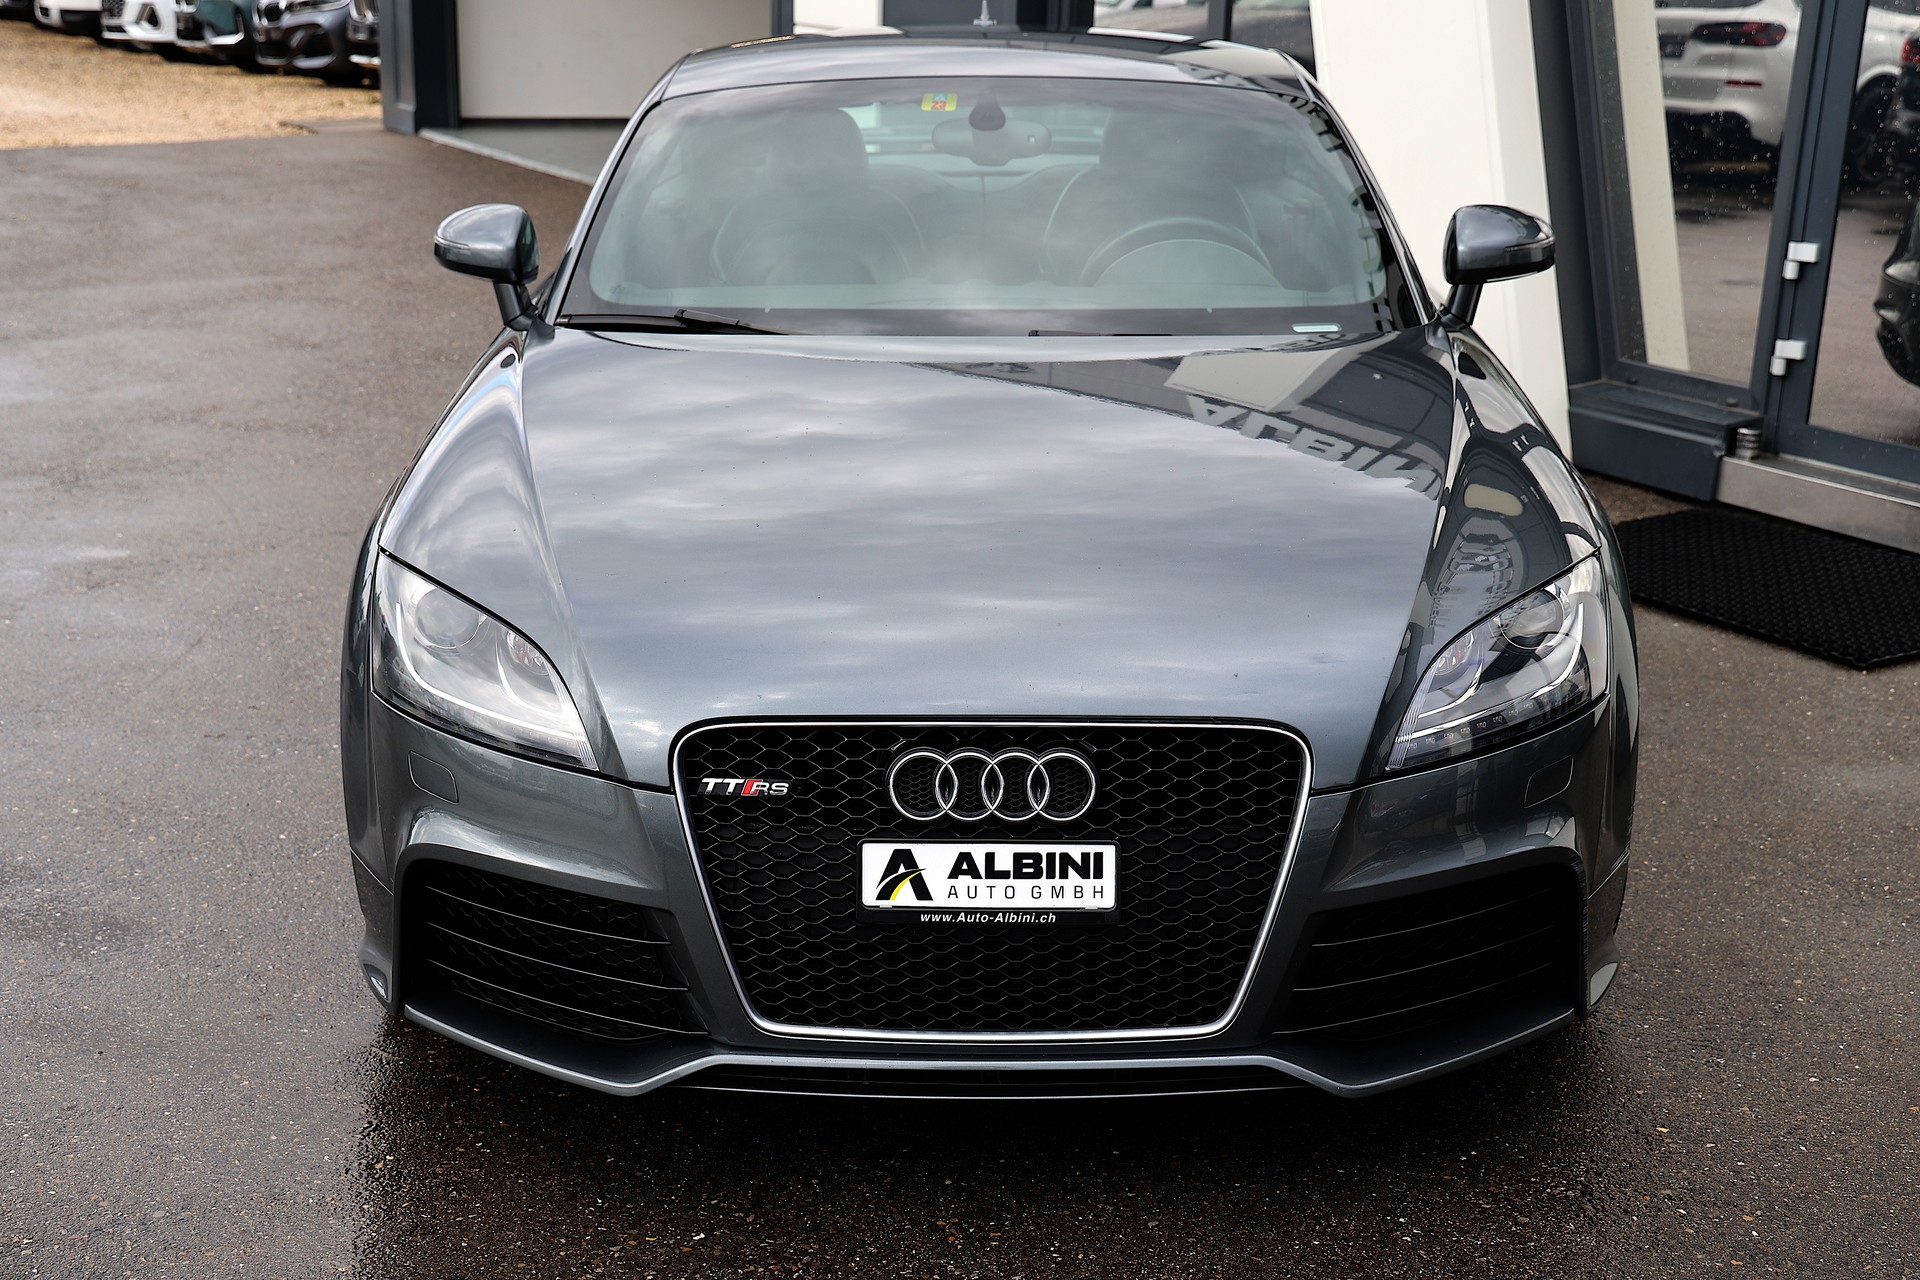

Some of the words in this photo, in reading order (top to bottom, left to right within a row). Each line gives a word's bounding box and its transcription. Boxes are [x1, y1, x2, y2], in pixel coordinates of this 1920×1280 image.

[947, 851, 1104, 880] ALBINI
[947, 884, 1016, 900] AUTO
[1030, 884, 1104, 900] GMBH
[920, 911, 1057, 924] www.Auto-Albini.ch
